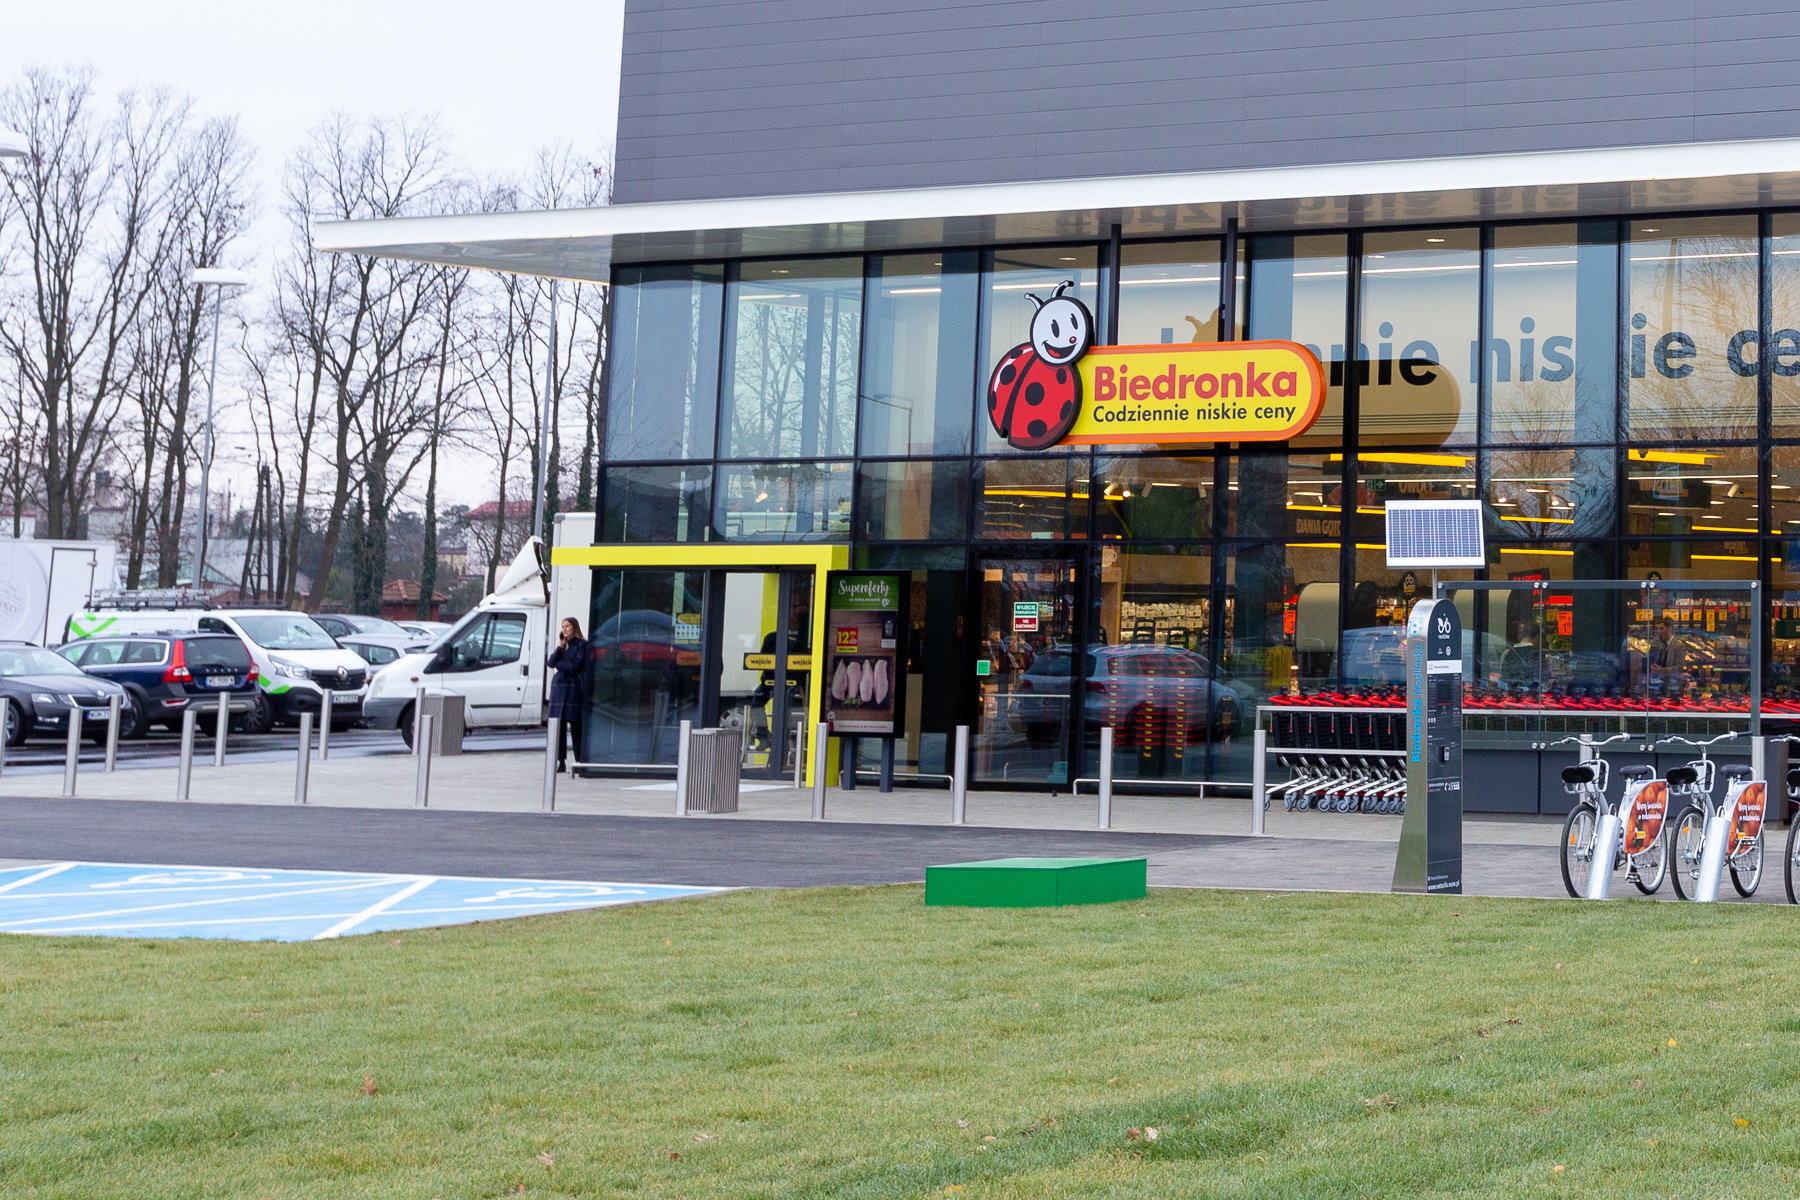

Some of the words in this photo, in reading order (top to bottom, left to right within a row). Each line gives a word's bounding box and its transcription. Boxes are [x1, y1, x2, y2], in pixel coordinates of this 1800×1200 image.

[1470, 312, 1697, 383] nisie
[1094, 361, 1298, 401] Biedronka
[1093, 403, 1189, 423] Codziennie
[1196, 402, 1247, 420] niskie
[1254, 405, 1296, 422] ceny
